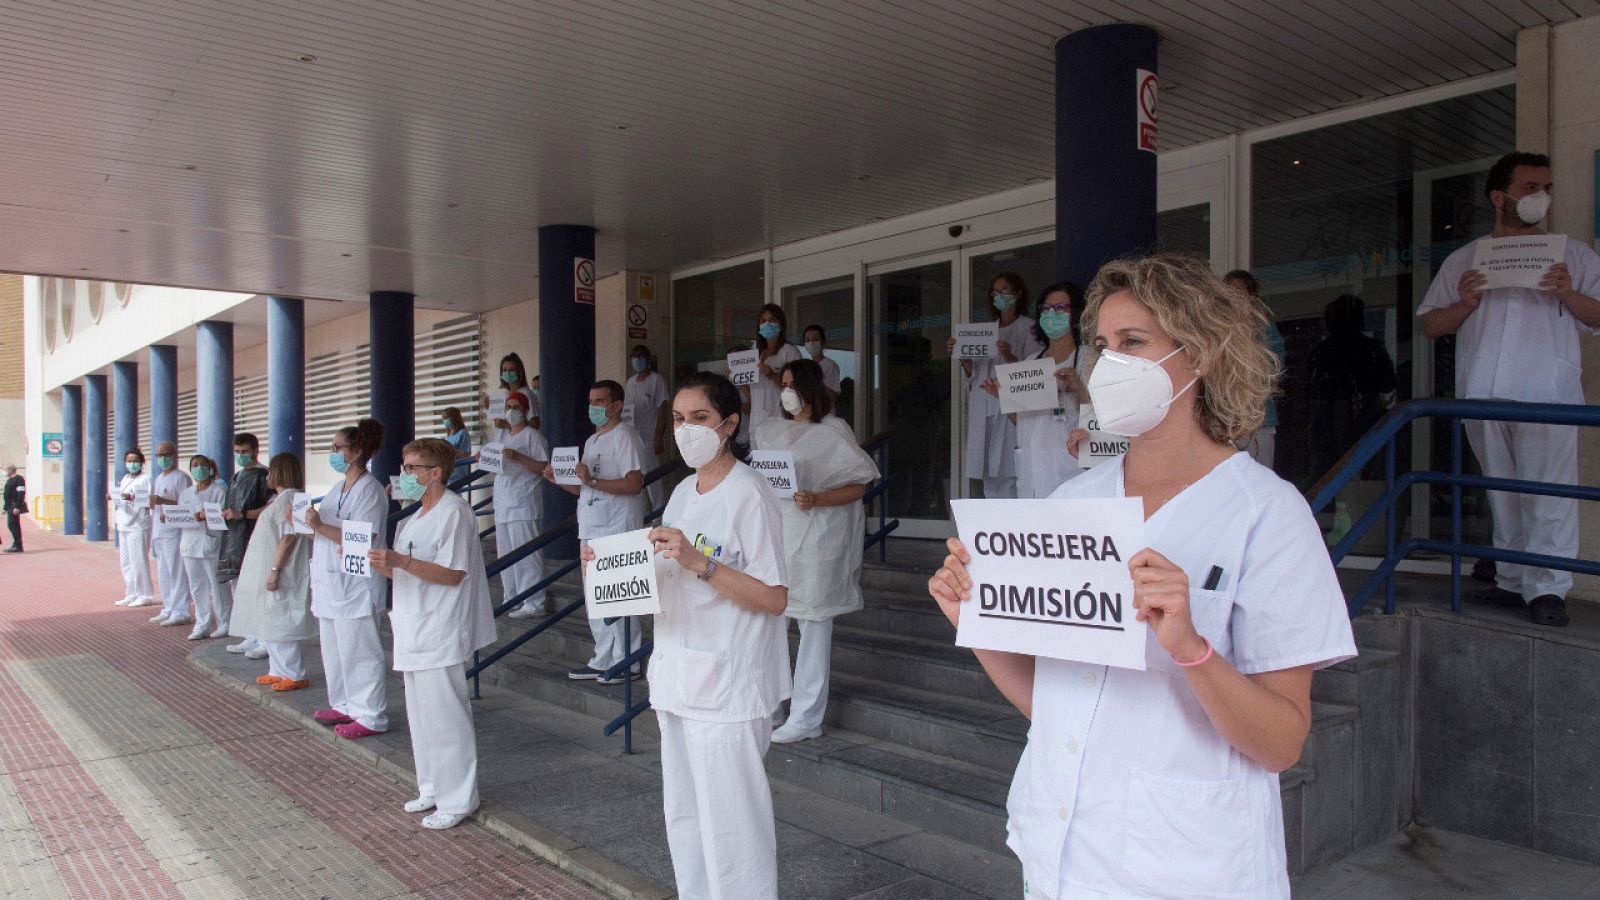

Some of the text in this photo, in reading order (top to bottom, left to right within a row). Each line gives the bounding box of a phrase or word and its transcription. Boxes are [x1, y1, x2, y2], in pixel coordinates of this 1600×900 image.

[958, 330, 994, 338] CONSEJERA
[960, 344, 989, 356] CESE
[733, 370, 755, 384] CESE
[1008, 368, 1045, 381] VENTURA
[751, 460, 789, 470] ONSEJERA
[974, 531, 1121, 562] CONSEJERA
[345, 554, 365, 575] CESE
[595, 549, 649, 571] CONSEJERA
[594, 576, 651, 600] DIMISIÓN
[979, 582, 1122, 623] DIMISIÓN
